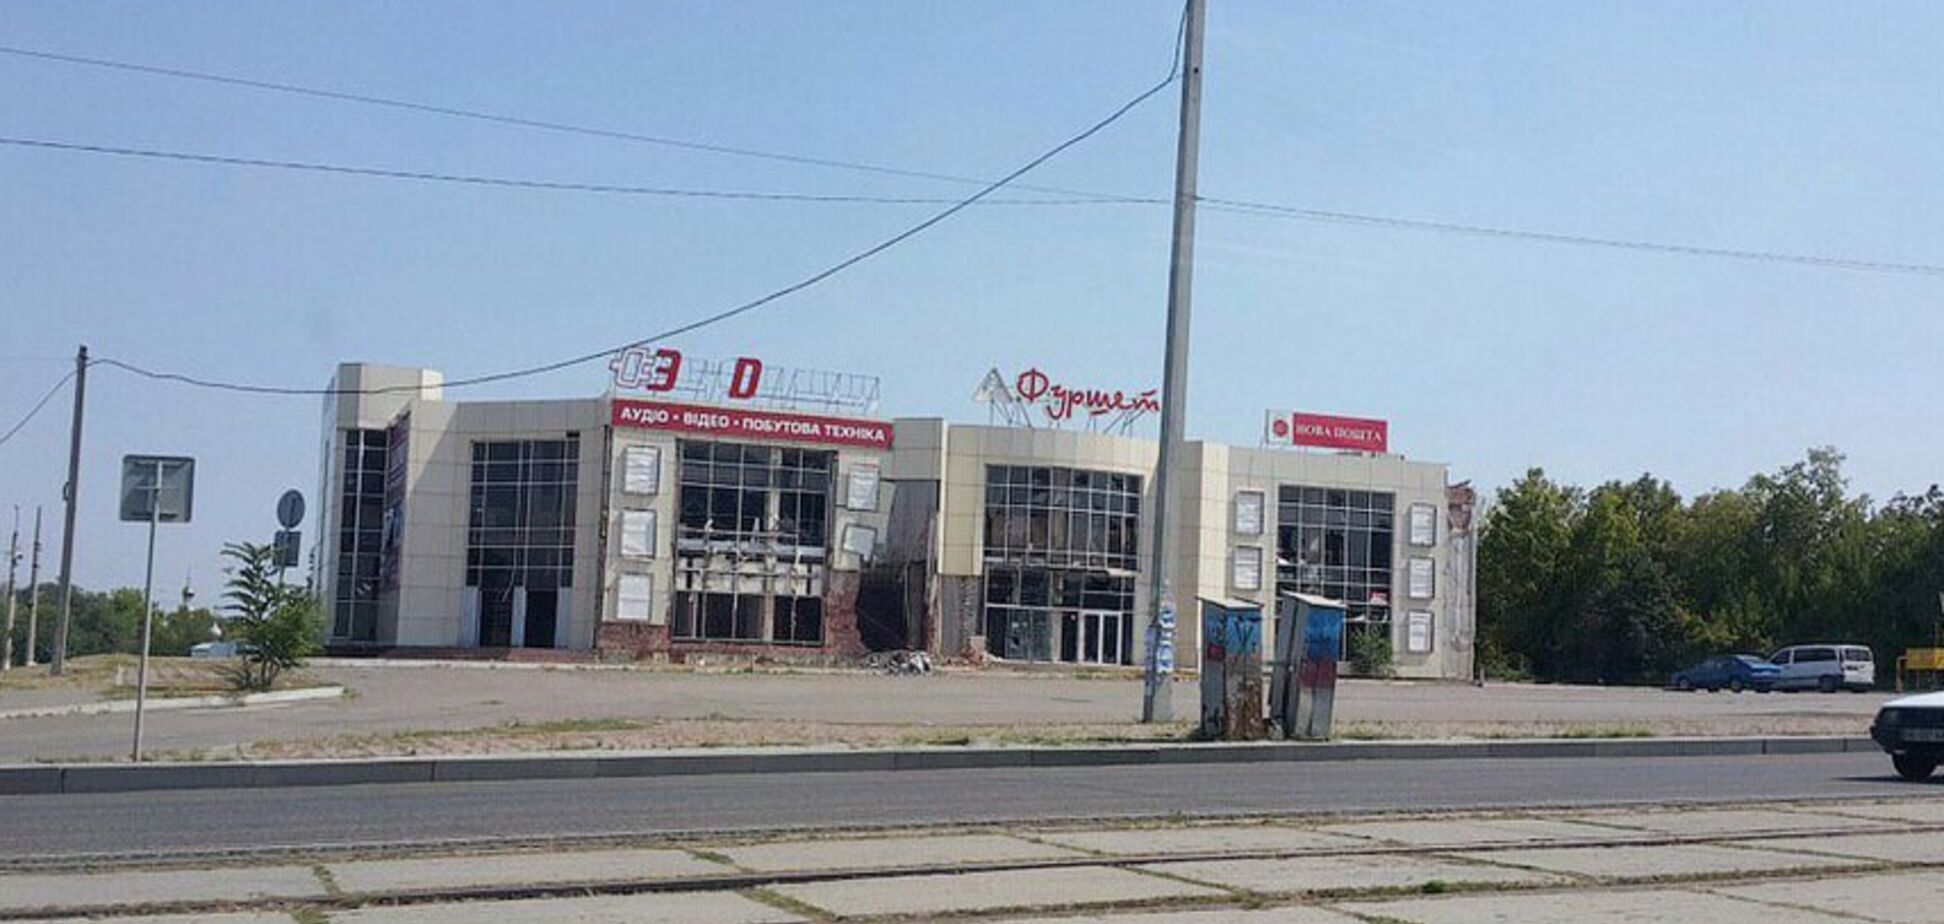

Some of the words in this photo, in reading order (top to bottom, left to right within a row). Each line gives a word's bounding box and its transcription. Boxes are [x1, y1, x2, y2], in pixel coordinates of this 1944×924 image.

[1016, 367, 1161, 420] Фуршет
[620, 407, 669, 424] АУДІО
[683, 412, 729, 429] ВІДЕО
[742, 418, 820, 437] ПОБУТОВА
[824, 424, 887, 442] ТЕХНІКА
[1295, 423, 1332, 438] НОВА
[1334, 426, 1382, 442] ПОШТА
